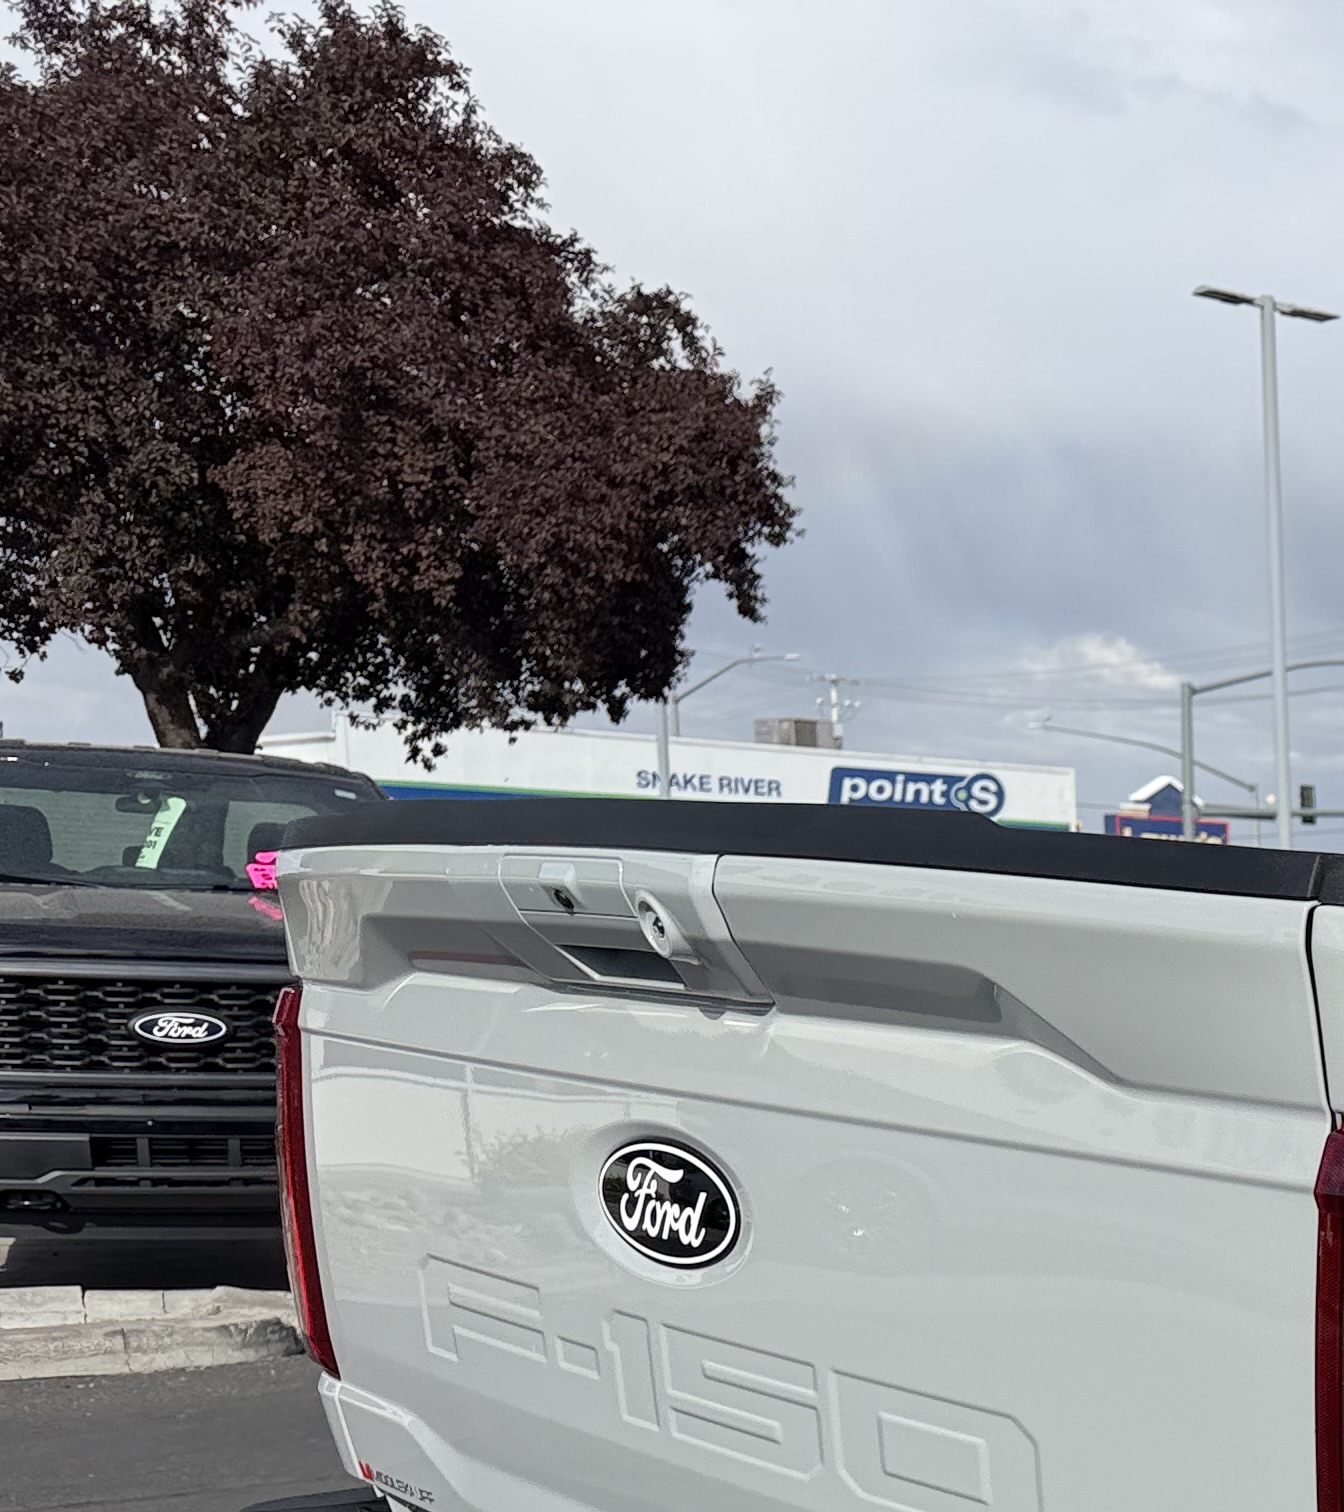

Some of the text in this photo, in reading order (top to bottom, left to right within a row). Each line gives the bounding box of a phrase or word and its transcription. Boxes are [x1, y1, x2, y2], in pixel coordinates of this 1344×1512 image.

[636, 769, 782, 798] SNAKE RIVER
[840, 774, 999, 814] point S
[153, 1015, 210, 1039] Ford
[619, 1156, 708, 1248] Ford
